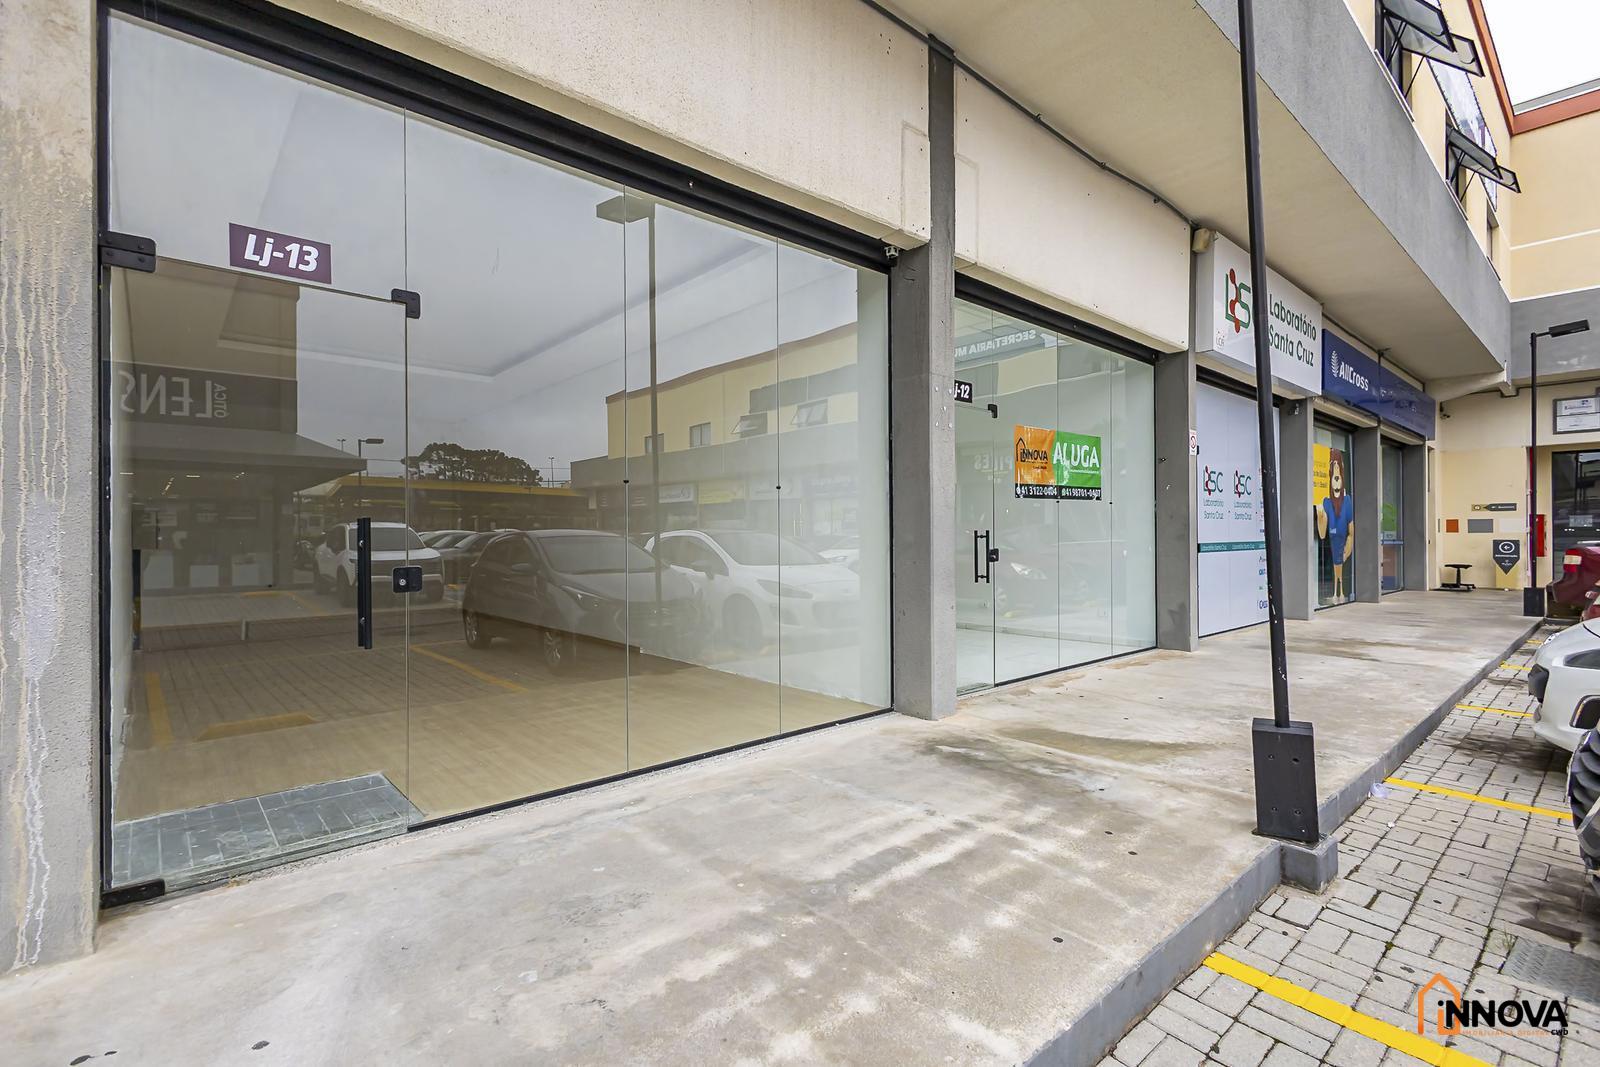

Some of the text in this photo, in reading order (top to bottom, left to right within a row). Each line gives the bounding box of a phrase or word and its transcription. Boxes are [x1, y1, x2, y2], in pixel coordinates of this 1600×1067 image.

[243, 233, 320, 272] Lj-13
[1269, 294, 1317, 342] Laboratório
[1268, 324, 1314, 367] Santa Cruz
[953, 382, 970, 399] j-12
[1339, 361, 1369, 392] AllCross
[1053, 442, 1100, 468] ALUGA
